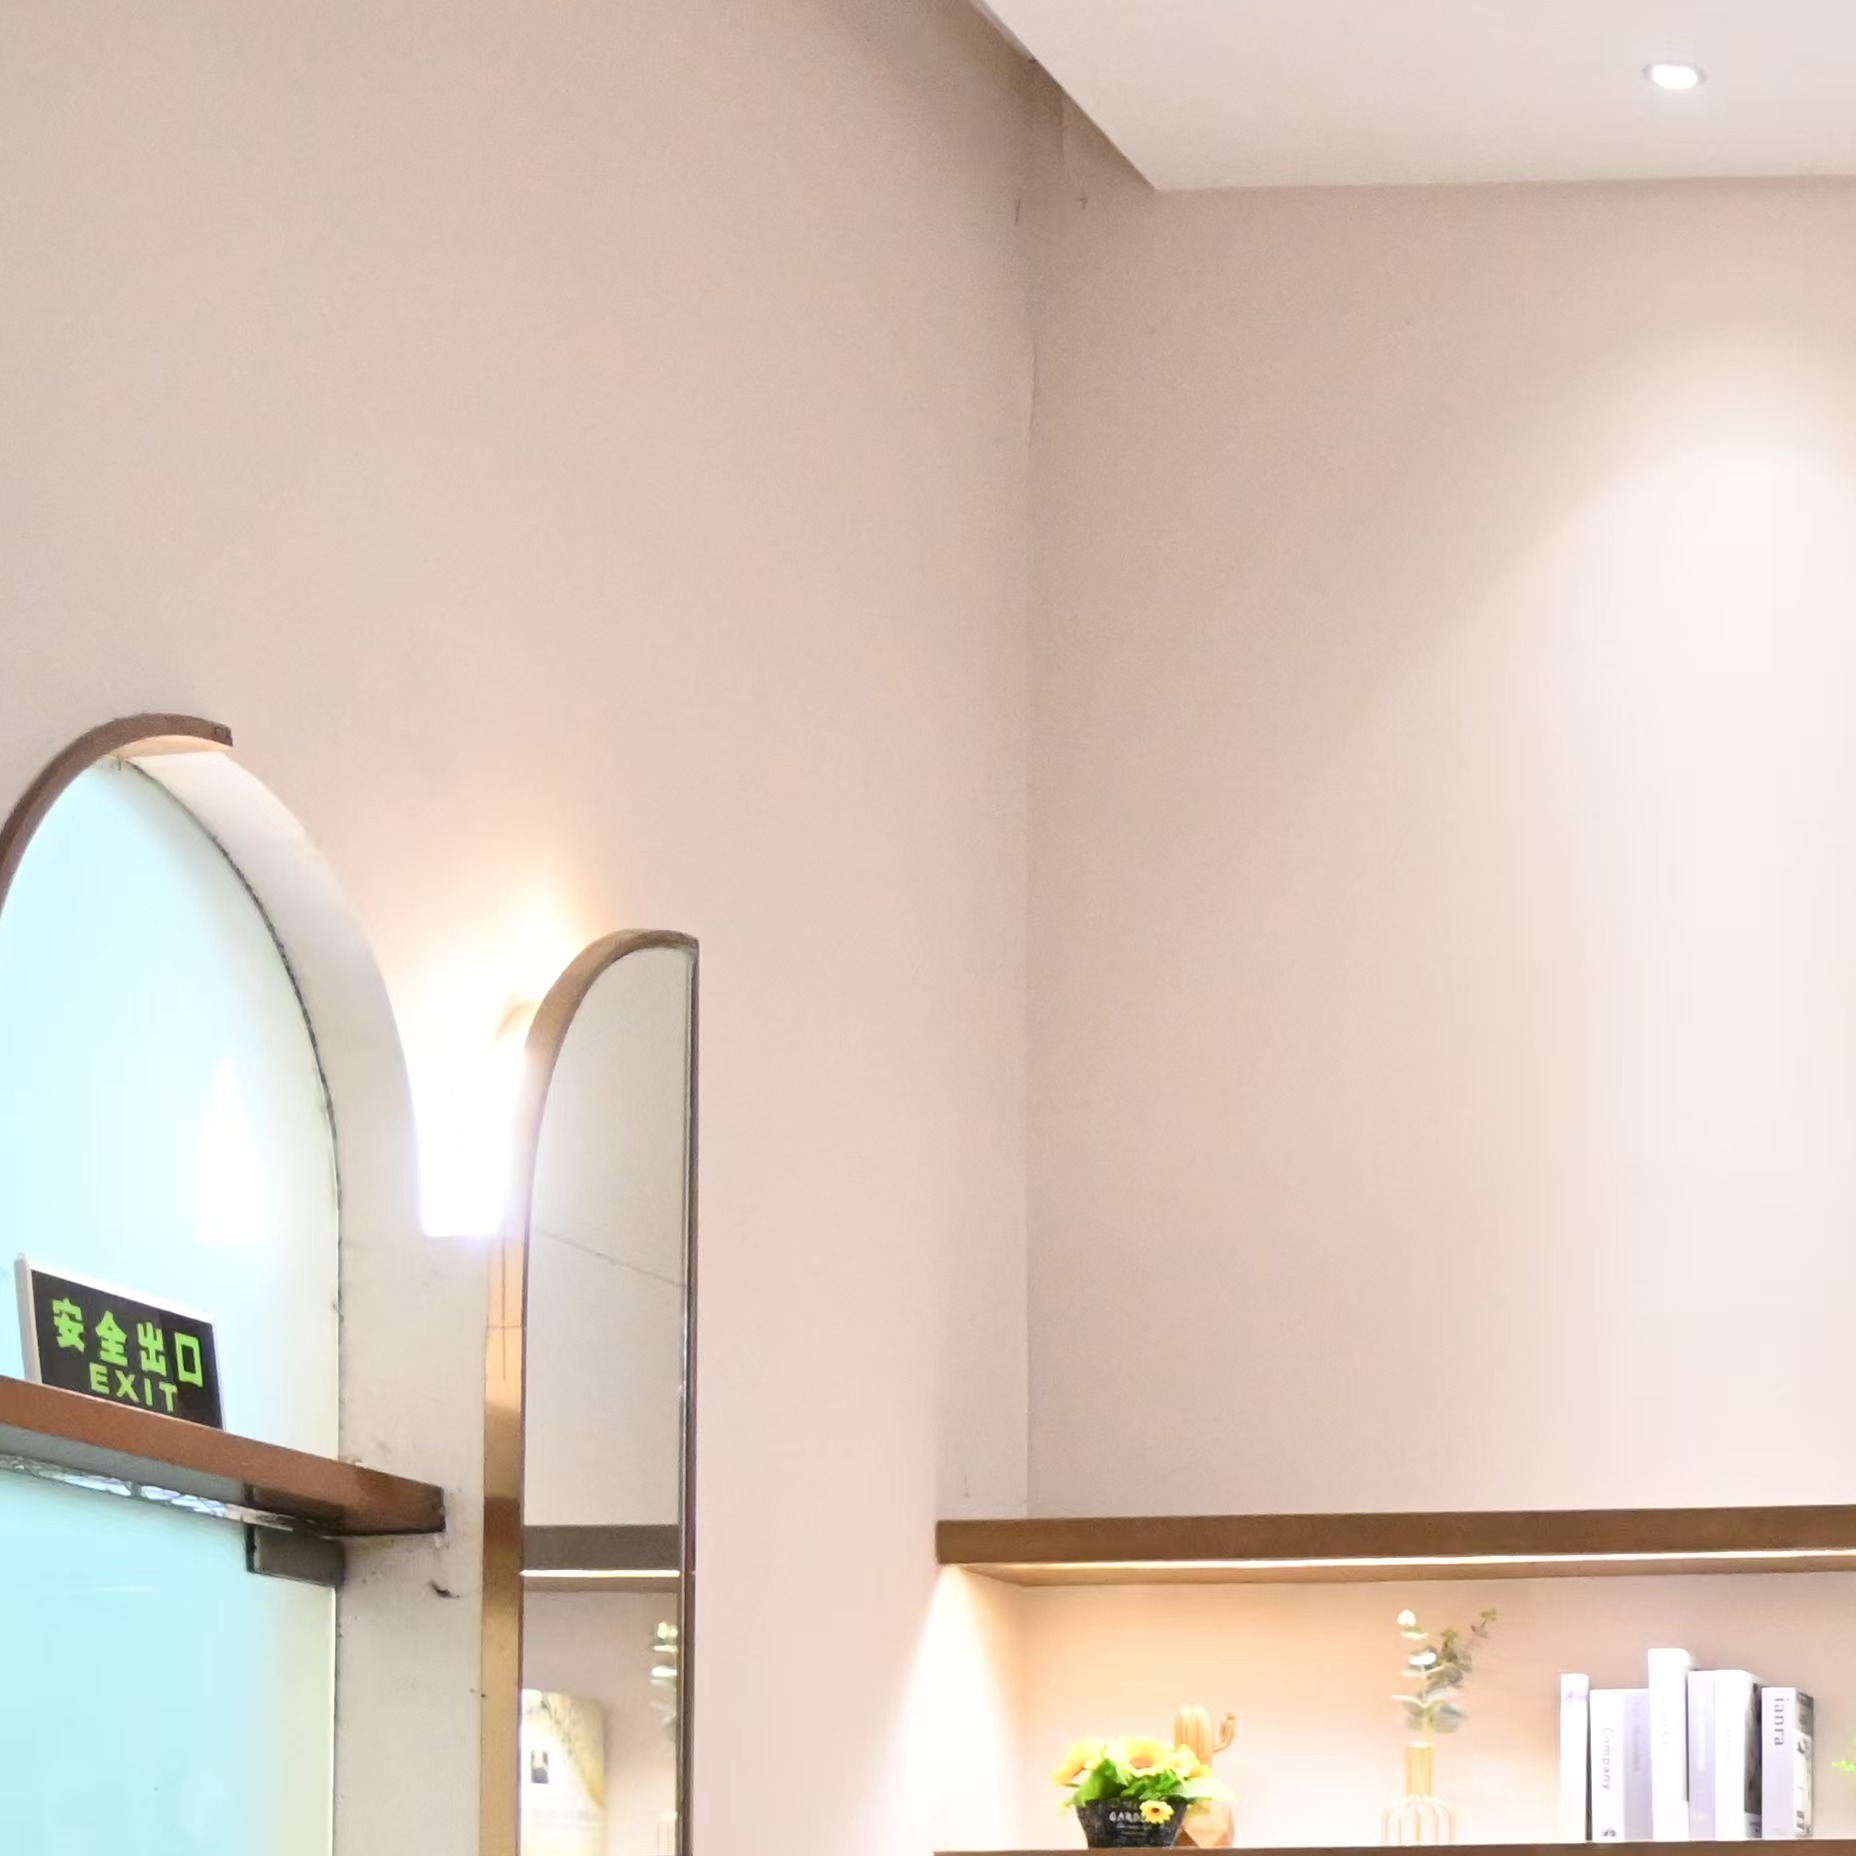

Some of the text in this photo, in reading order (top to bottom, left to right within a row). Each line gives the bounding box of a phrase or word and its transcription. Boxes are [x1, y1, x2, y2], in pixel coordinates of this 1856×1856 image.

[53, 1298, 204, 1387] 安全出口
[89, 1362, 178, 1412] EXIT
[1601, 1727, 1614, 1790] Company
